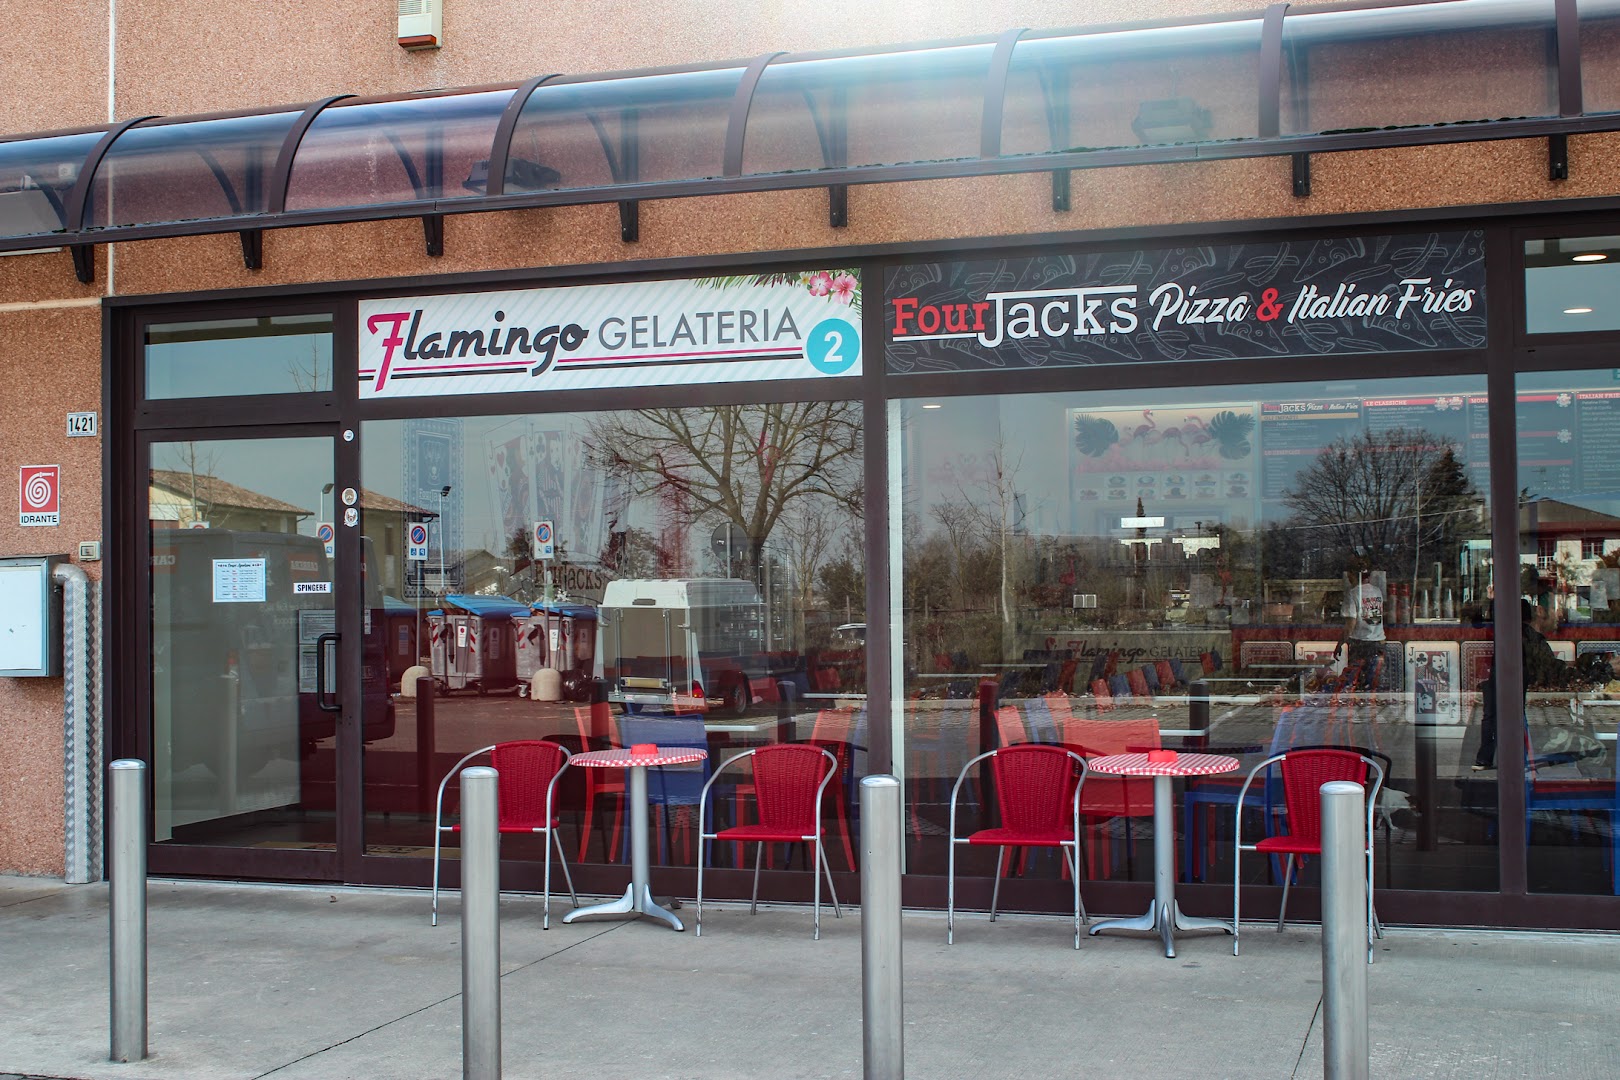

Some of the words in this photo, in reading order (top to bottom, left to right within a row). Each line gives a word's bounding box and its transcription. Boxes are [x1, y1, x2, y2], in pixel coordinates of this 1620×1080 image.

[1149, 282, 1253, 332] Pizza
[1256, 288, 1283, 322] &
[1287, 282, 1391, 323] Italian
[1395, 278, 1476, 320] Fries
[367, 309, 588, 392] Flamingo
[599, 307, 802, 350] GELATERIA
[823, 331, 843, 363] 2
[69, 416, 94, 432] 1421
[21, 513, 58, 525] IDRANTE
[297, 583, 327, 593] SPINGERE
[1408, 647, 1414, 656] J
